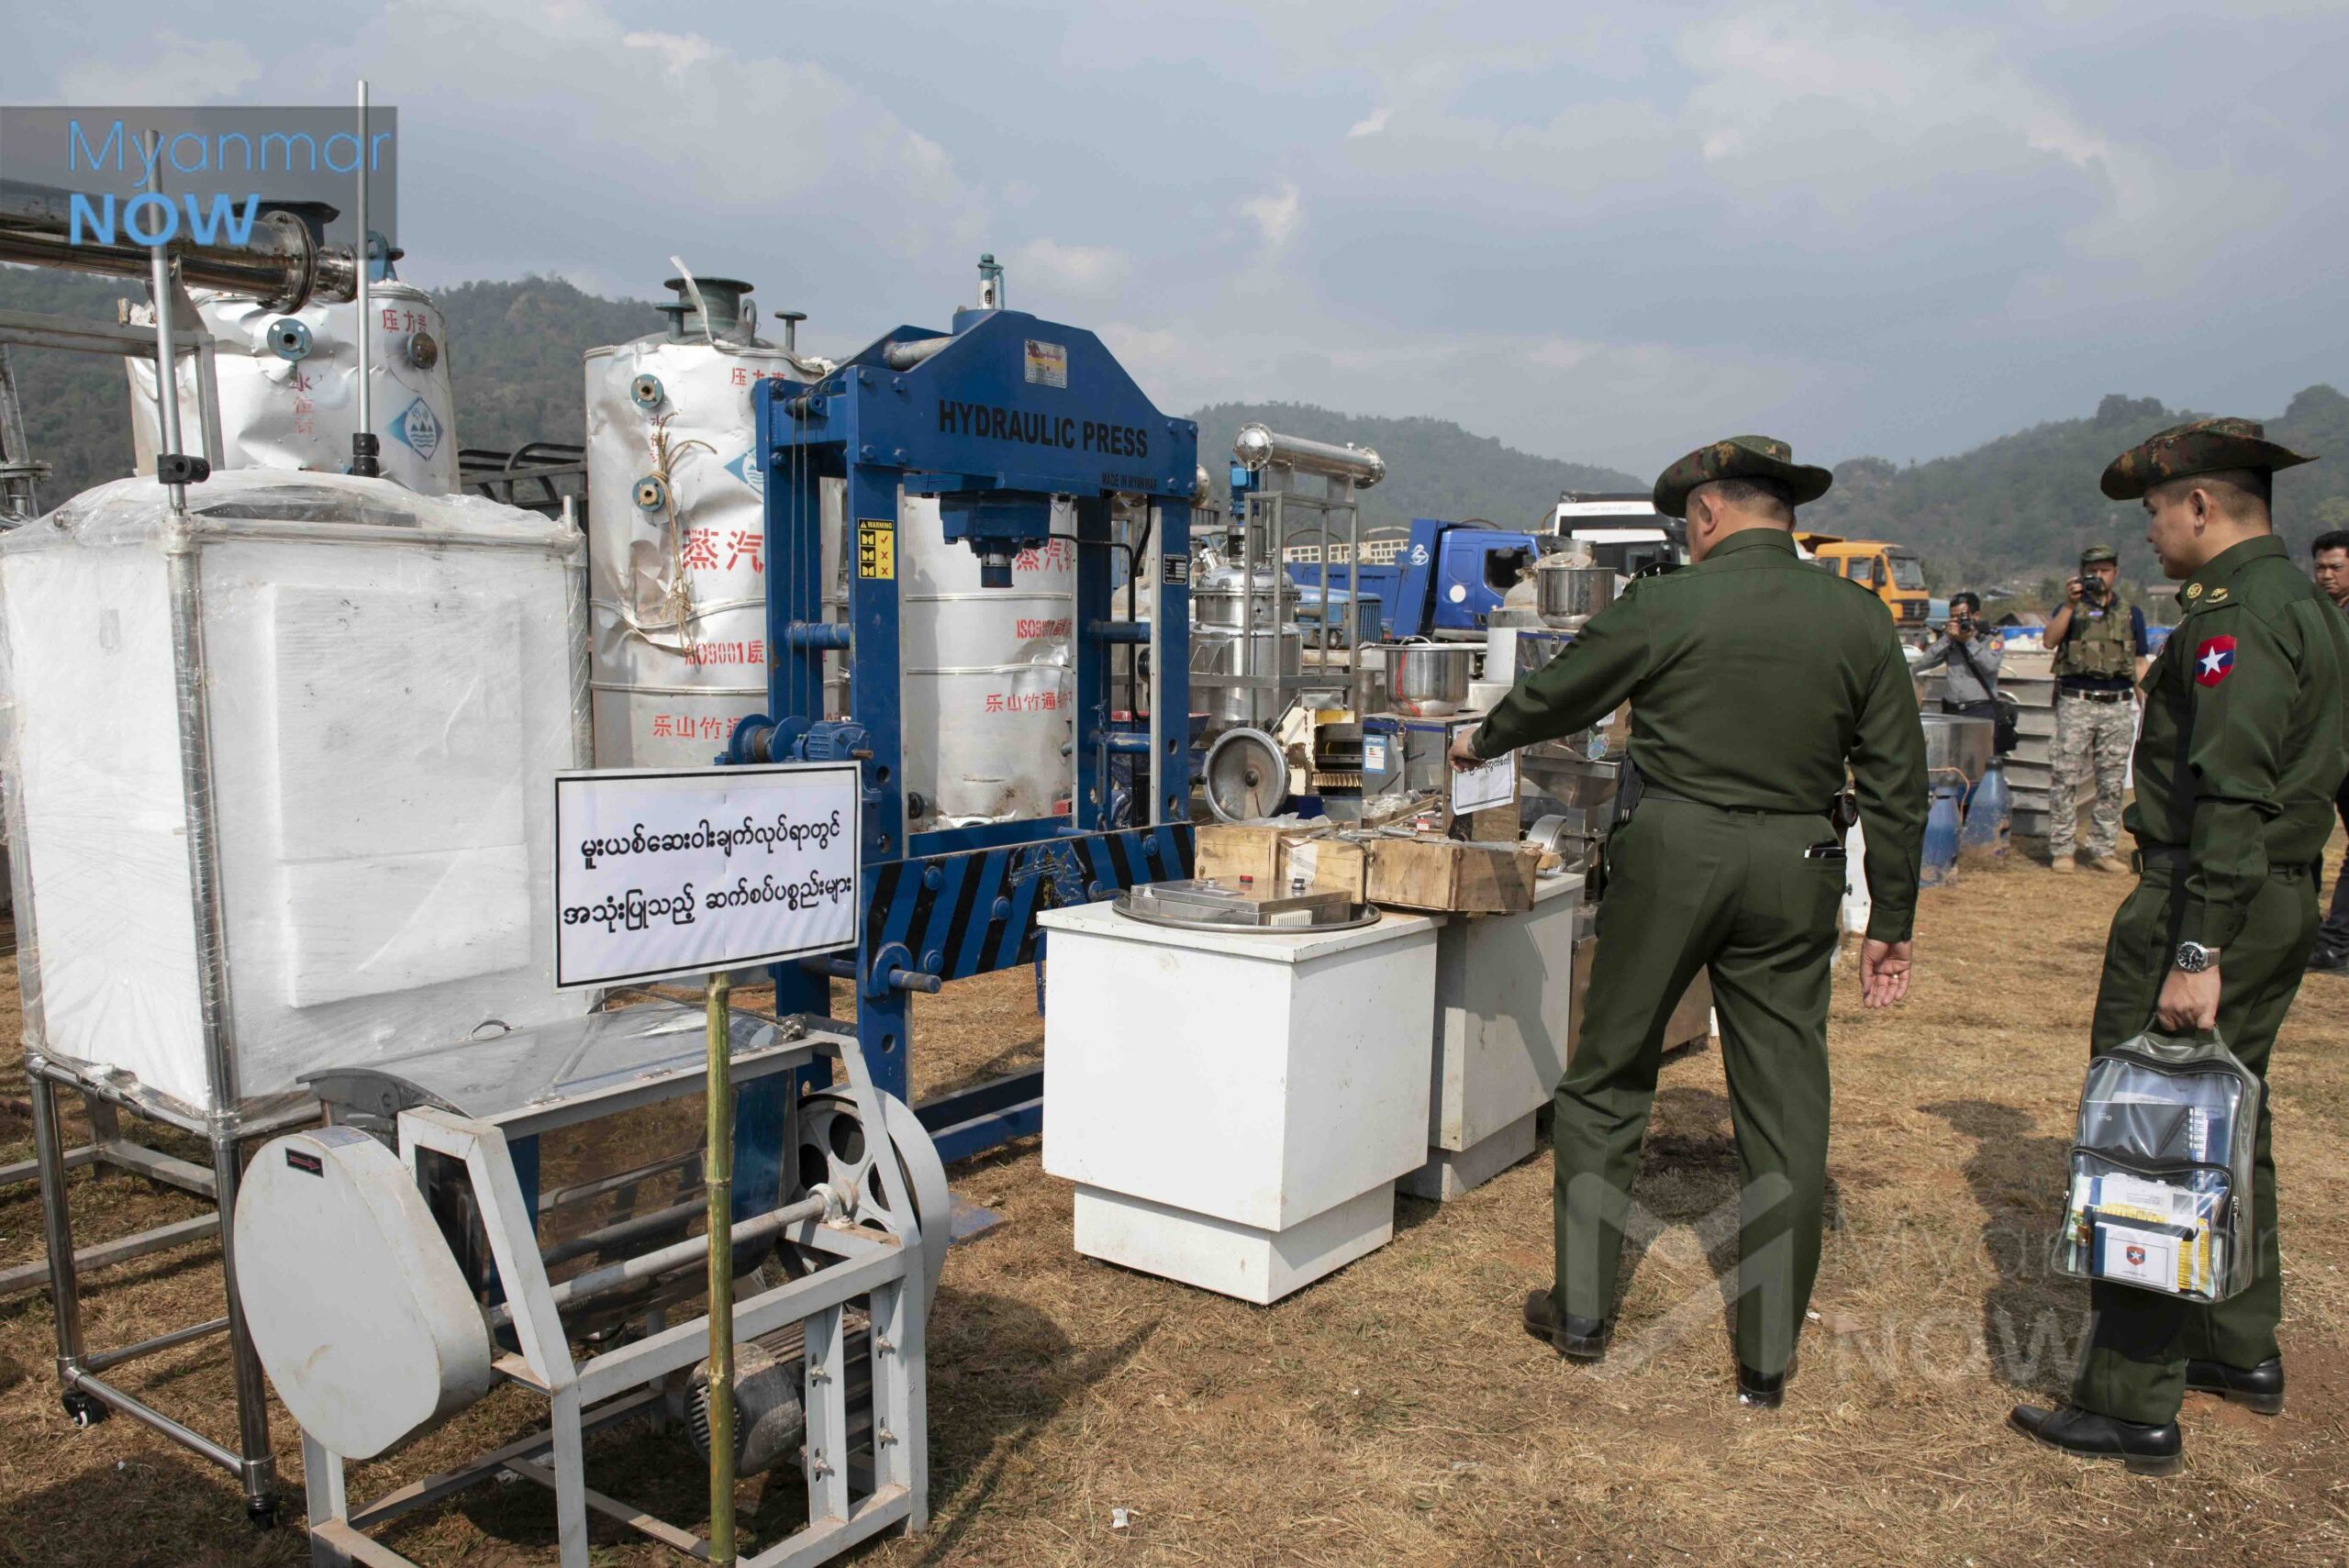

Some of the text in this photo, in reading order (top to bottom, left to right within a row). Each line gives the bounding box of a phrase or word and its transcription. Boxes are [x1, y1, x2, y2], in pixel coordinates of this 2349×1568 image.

[939, 399, 1148, 459] HYDRAULIC PRESS
[1101, 471, 1119, 486] MADE
[867, 520, 893, 529] WARNING
[683, 528, 764, 573] 蒸汽
[581, 810, 840, 870] မူးယစ်ဆေးဝါးချက်လုပ်ရာတွင်
[706, 870, 852, 910] ဆက်စပ်ပစ္စည်းများ
